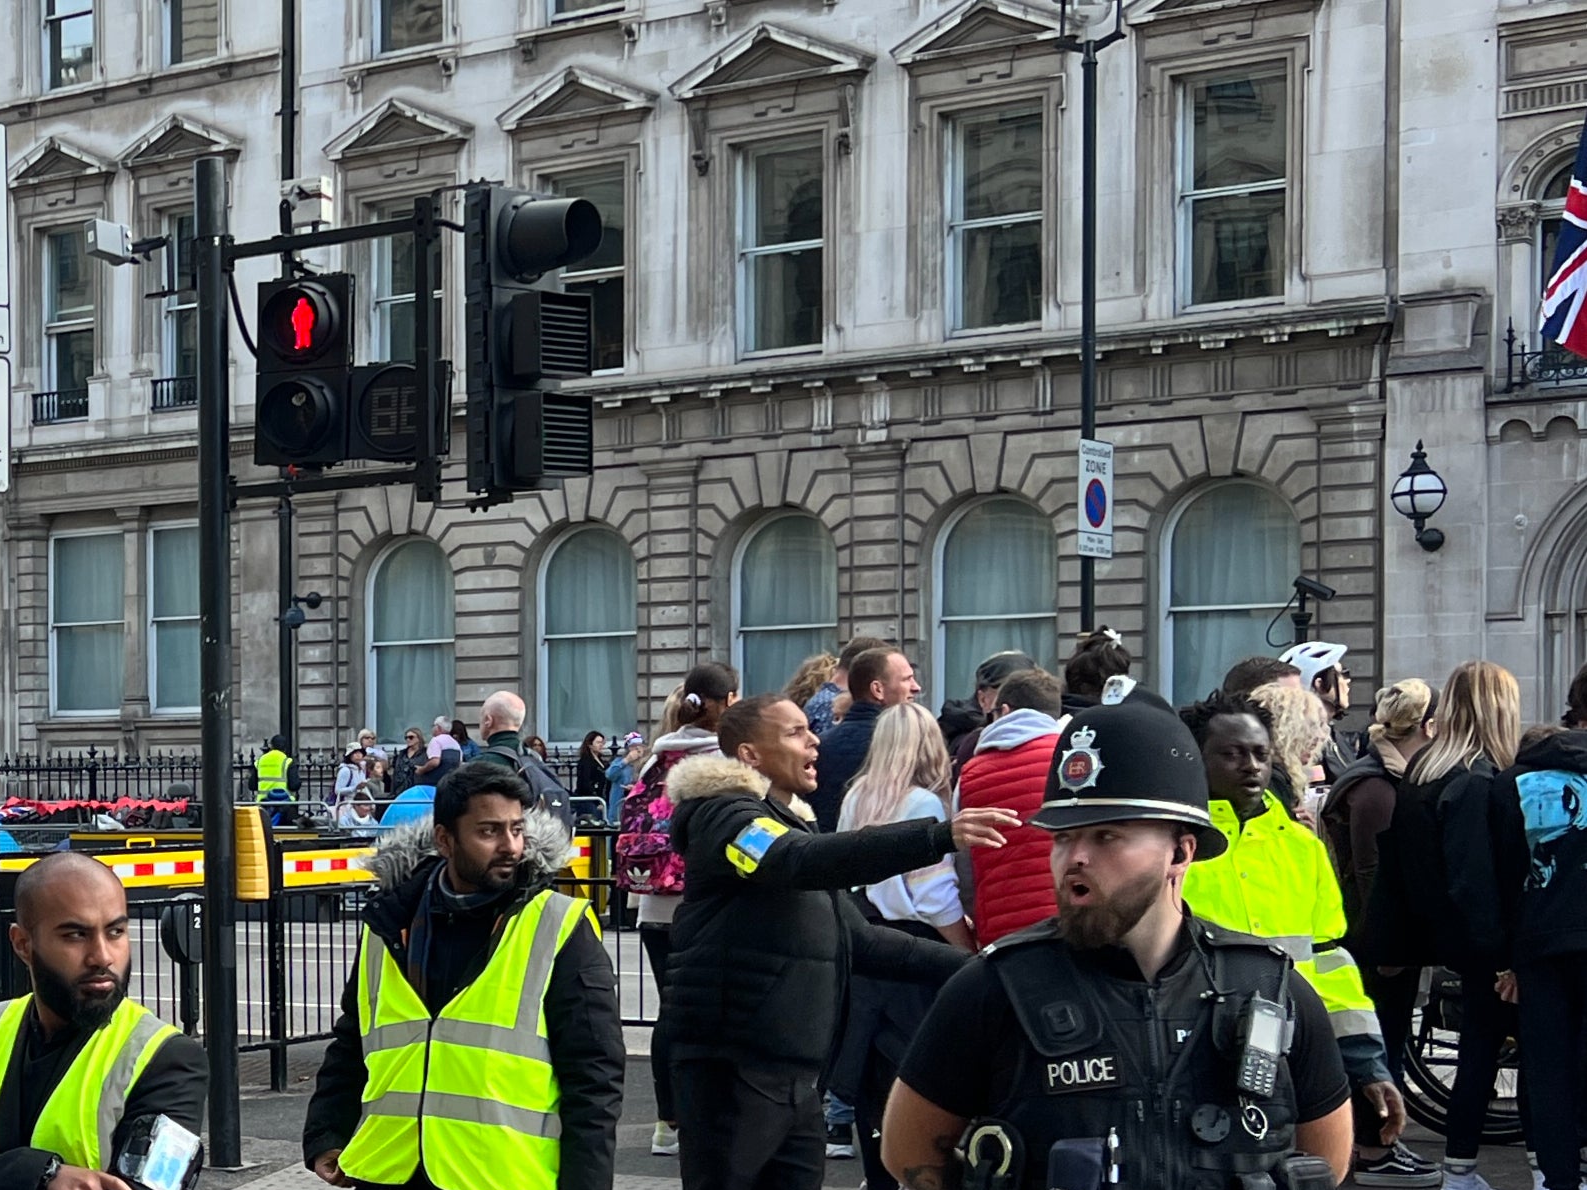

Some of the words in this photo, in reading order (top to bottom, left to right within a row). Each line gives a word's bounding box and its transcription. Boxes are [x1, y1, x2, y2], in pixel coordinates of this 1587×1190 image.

[1081, 444, 1112, 459] Controlled
[1085, 459, 1107, 475] ZONE
[1047, 1057, 1116, 1087] POLICE
